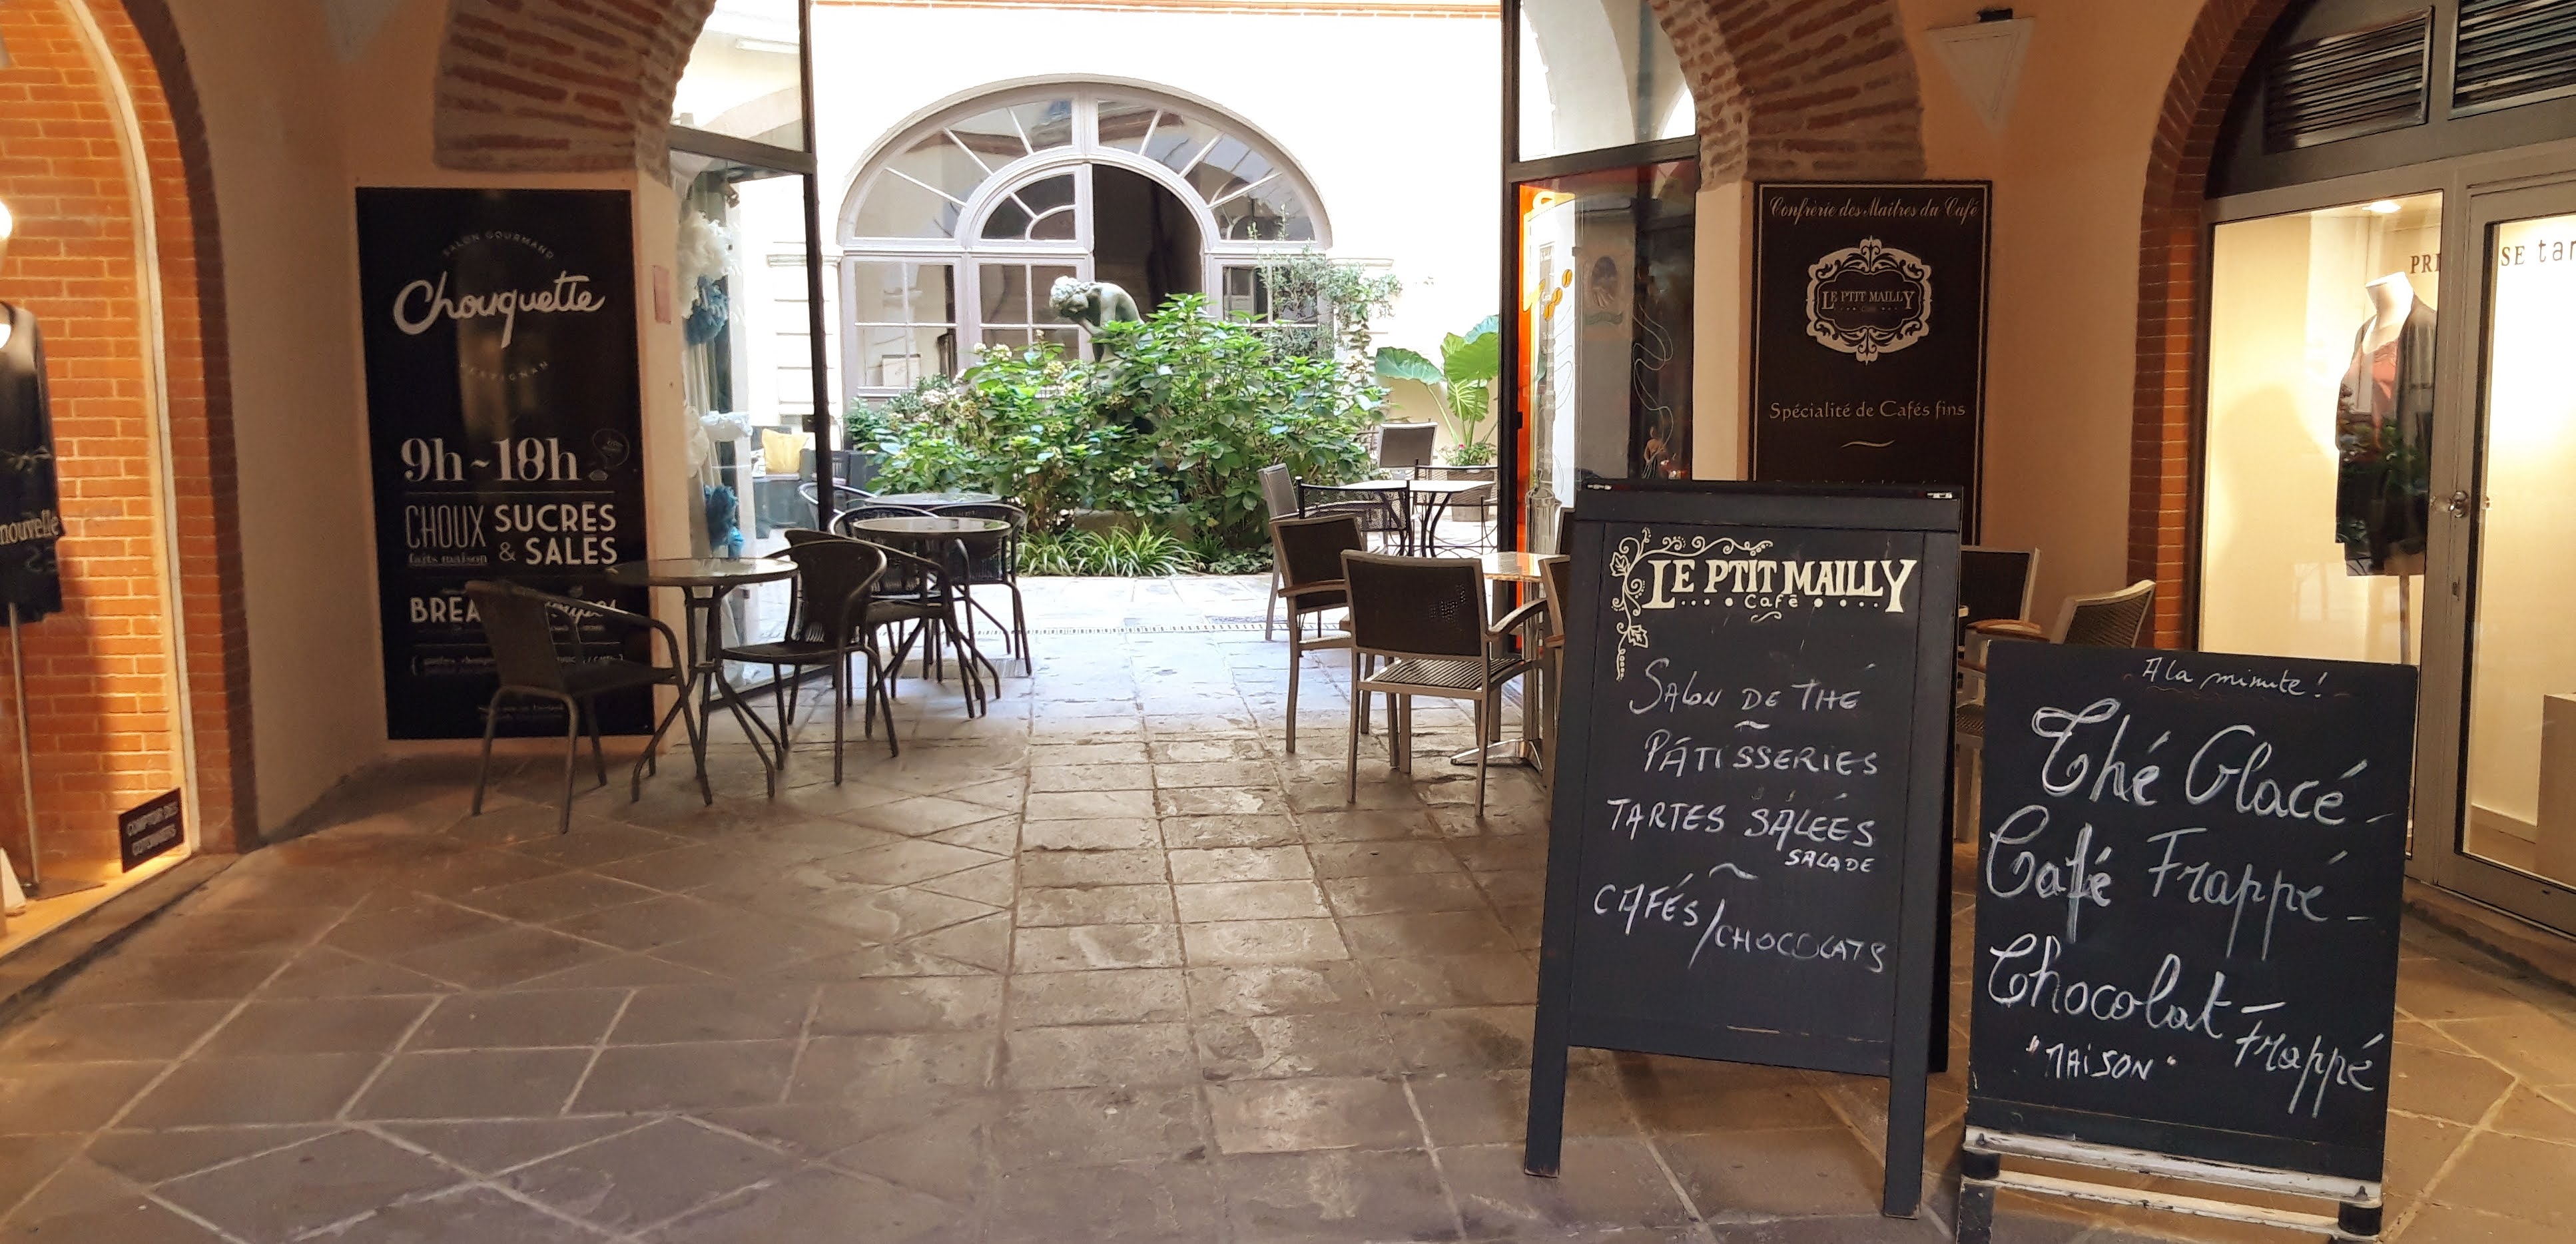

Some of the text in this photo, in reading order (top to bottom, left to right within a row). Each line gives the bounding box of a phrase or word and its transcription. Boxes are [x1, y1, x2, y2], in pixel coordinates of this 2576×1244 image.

[1839, 198, 1861, 217] des
[1920, 198, 1939, 217] du
[1945, 196, 1981, 225] Café
[393, 270, 607, 348] Chouquette
[1821, 291, 1915, 310] LE PTIT MAILLY
[1769, 400, 1965, 422] Spécialité de Cafés fins
[0, 509, 59, 546] nouvelle
[405, 504, 486, 549] CHOUX
[499, 541, 516, 562] &
[1642, 559, 1917, 613] LE PTIT MAILLY
[2166, 660, 2194, 682] la
[2200, 669, 2306, 696] minute
[1742, 688, 1781, 711] DE
[2032, 698, 2171, 807] Thé
[2185, 725, 2368, 825] Glacé
[1607, 798, 1726, 841] TARTES
[1785, 848, 1875, 872] SALADE
[1987, 804, 2112, 944] Café
[2146, 828, 2348, 960] Frappé
[1988, 933, 2232, 1038] Chocolat
